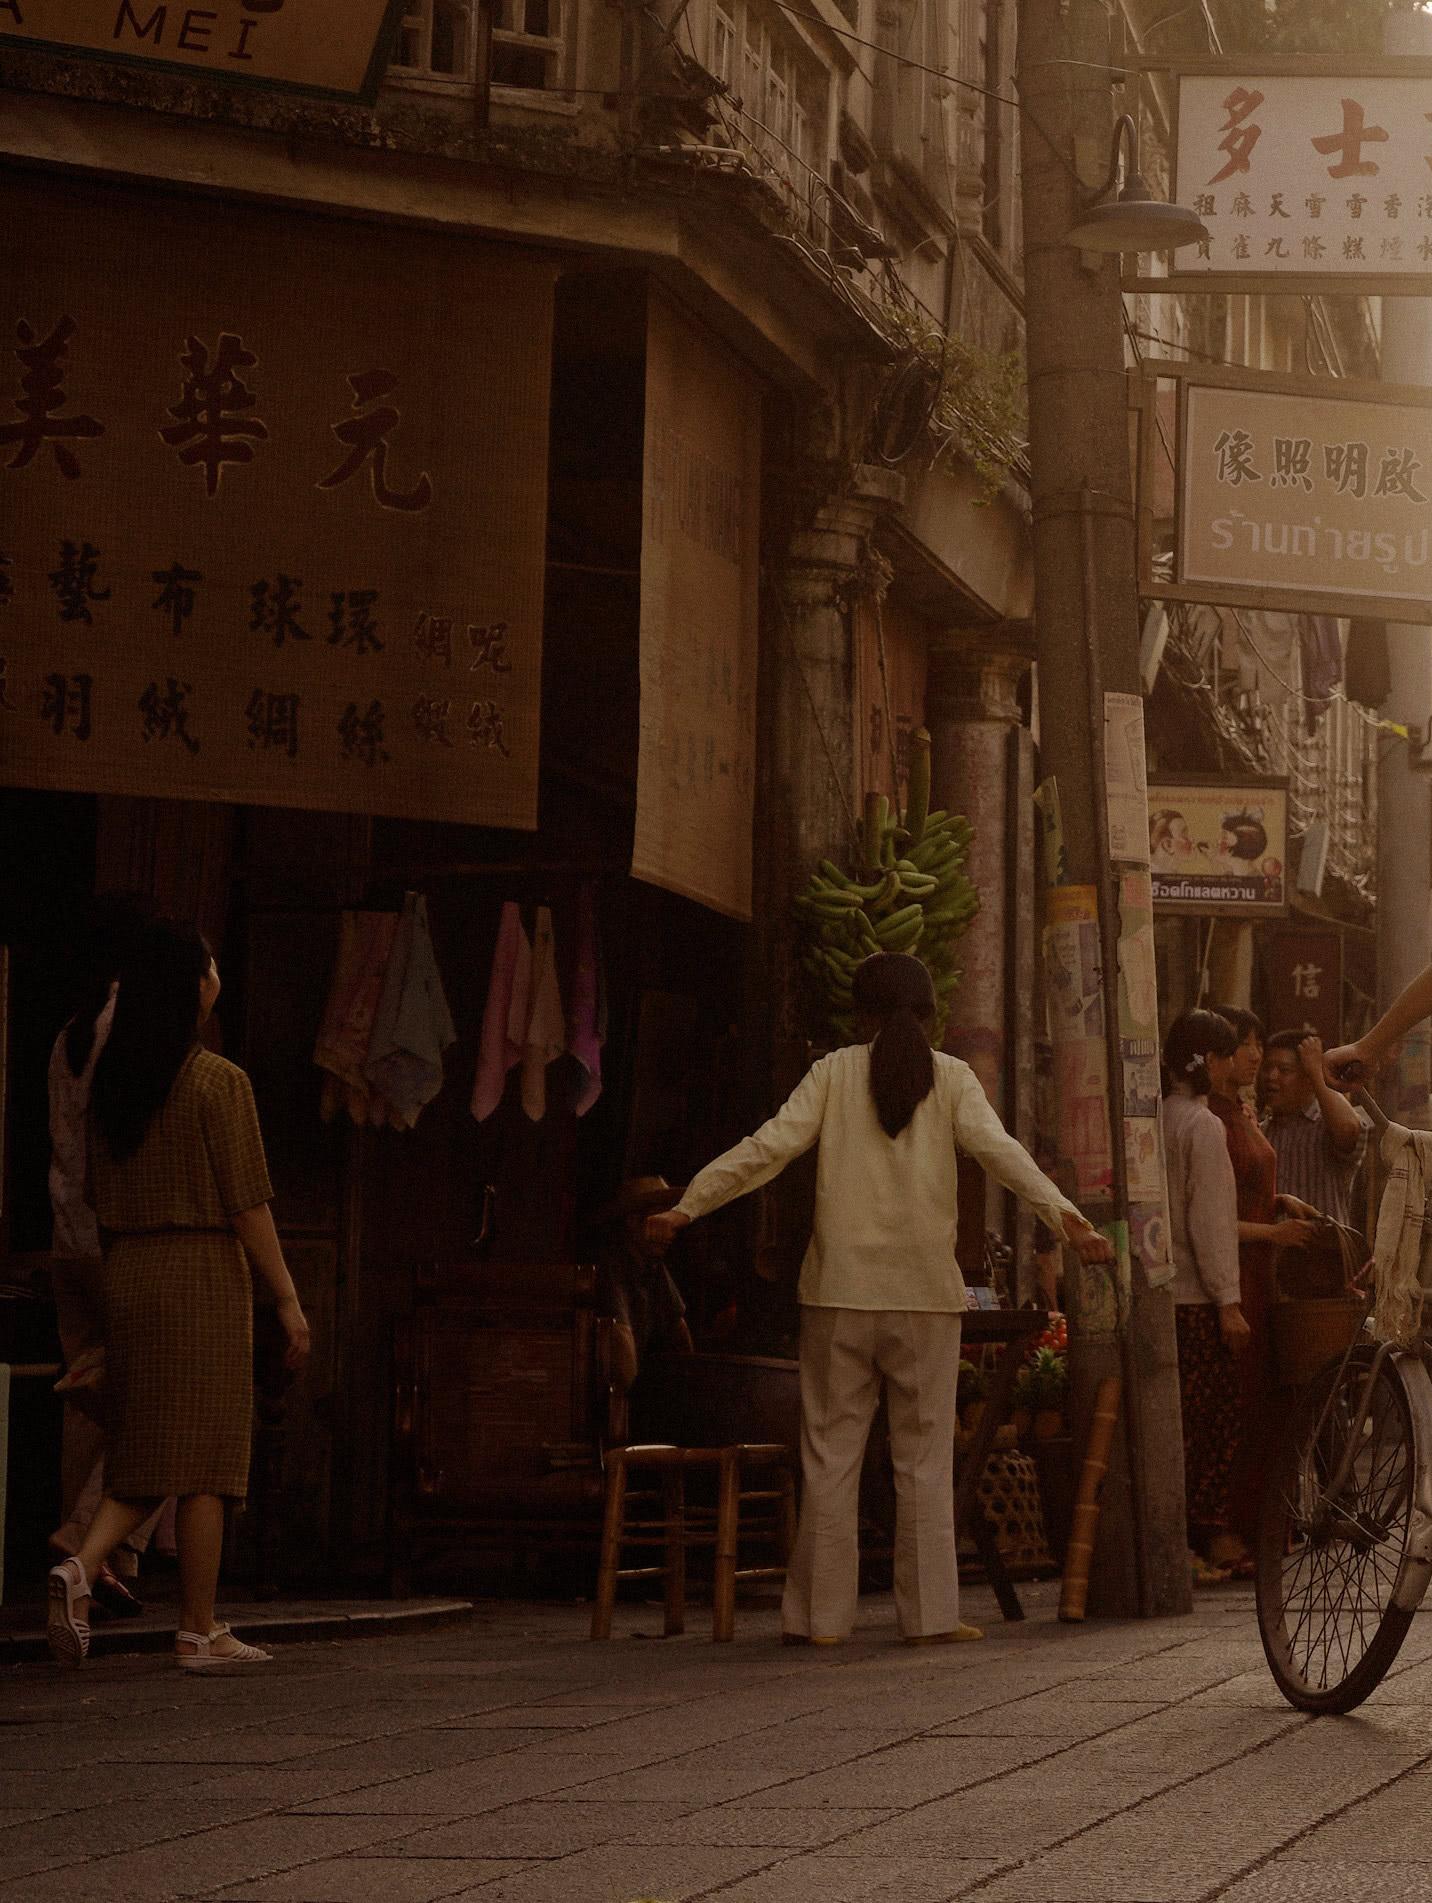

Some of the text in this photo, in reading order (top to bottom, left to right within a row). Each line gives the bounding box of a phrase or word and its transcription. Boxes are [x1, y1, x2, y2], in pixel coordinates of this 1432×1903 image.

[113, 0, 257, 60] MEI
[1211, 509, 1429, 574] ร้านถ่ายรูป
